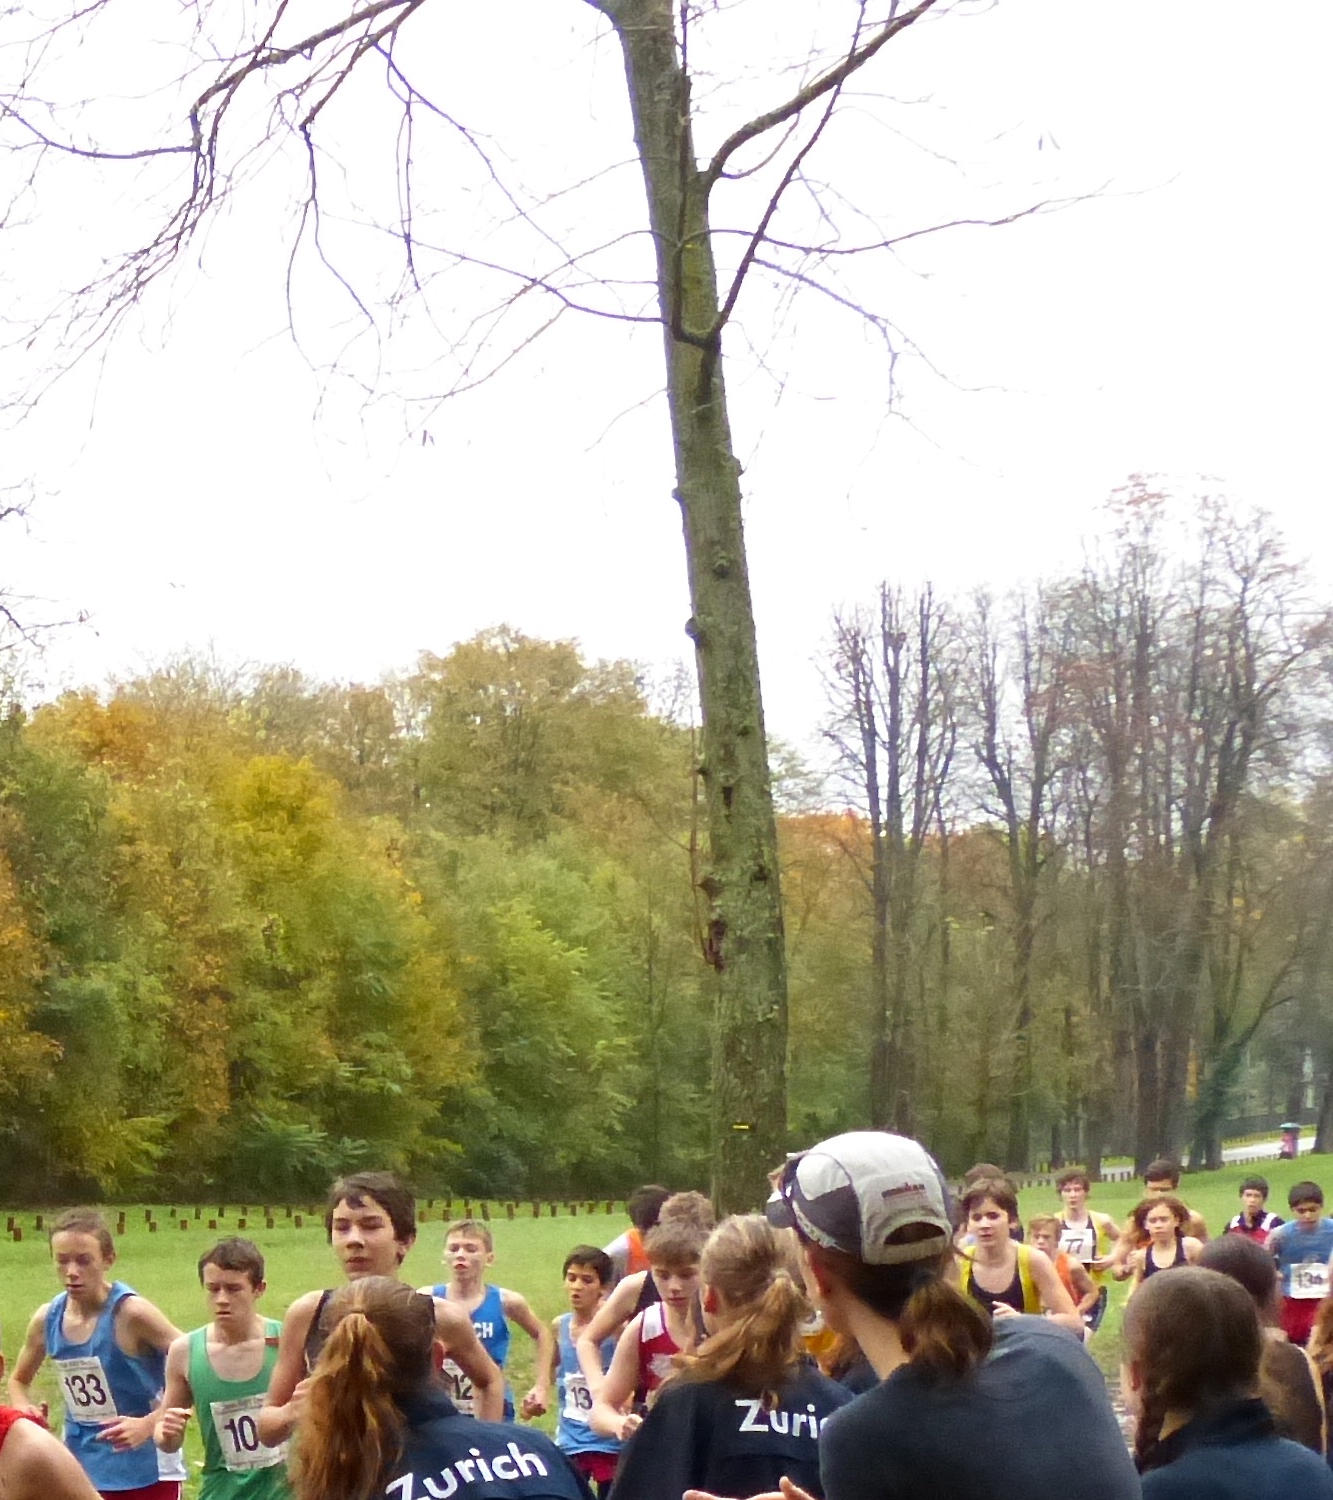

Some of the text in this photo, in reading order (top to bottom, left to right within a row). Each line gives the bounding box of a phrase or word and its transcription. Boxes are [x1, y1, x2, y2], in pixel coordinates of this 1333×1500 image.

[1065, 1238, 1084, 1254] 77
[472, 1322, 494, 1338] CH
[64, 1373, 107, 1407] 133
[452, 1373, 474, 1400] 12
[570, 1386, 594, 1410] 13
[735, 1399, 829, 1439] Zuri
[224, 1415, 260, 1453] 10
